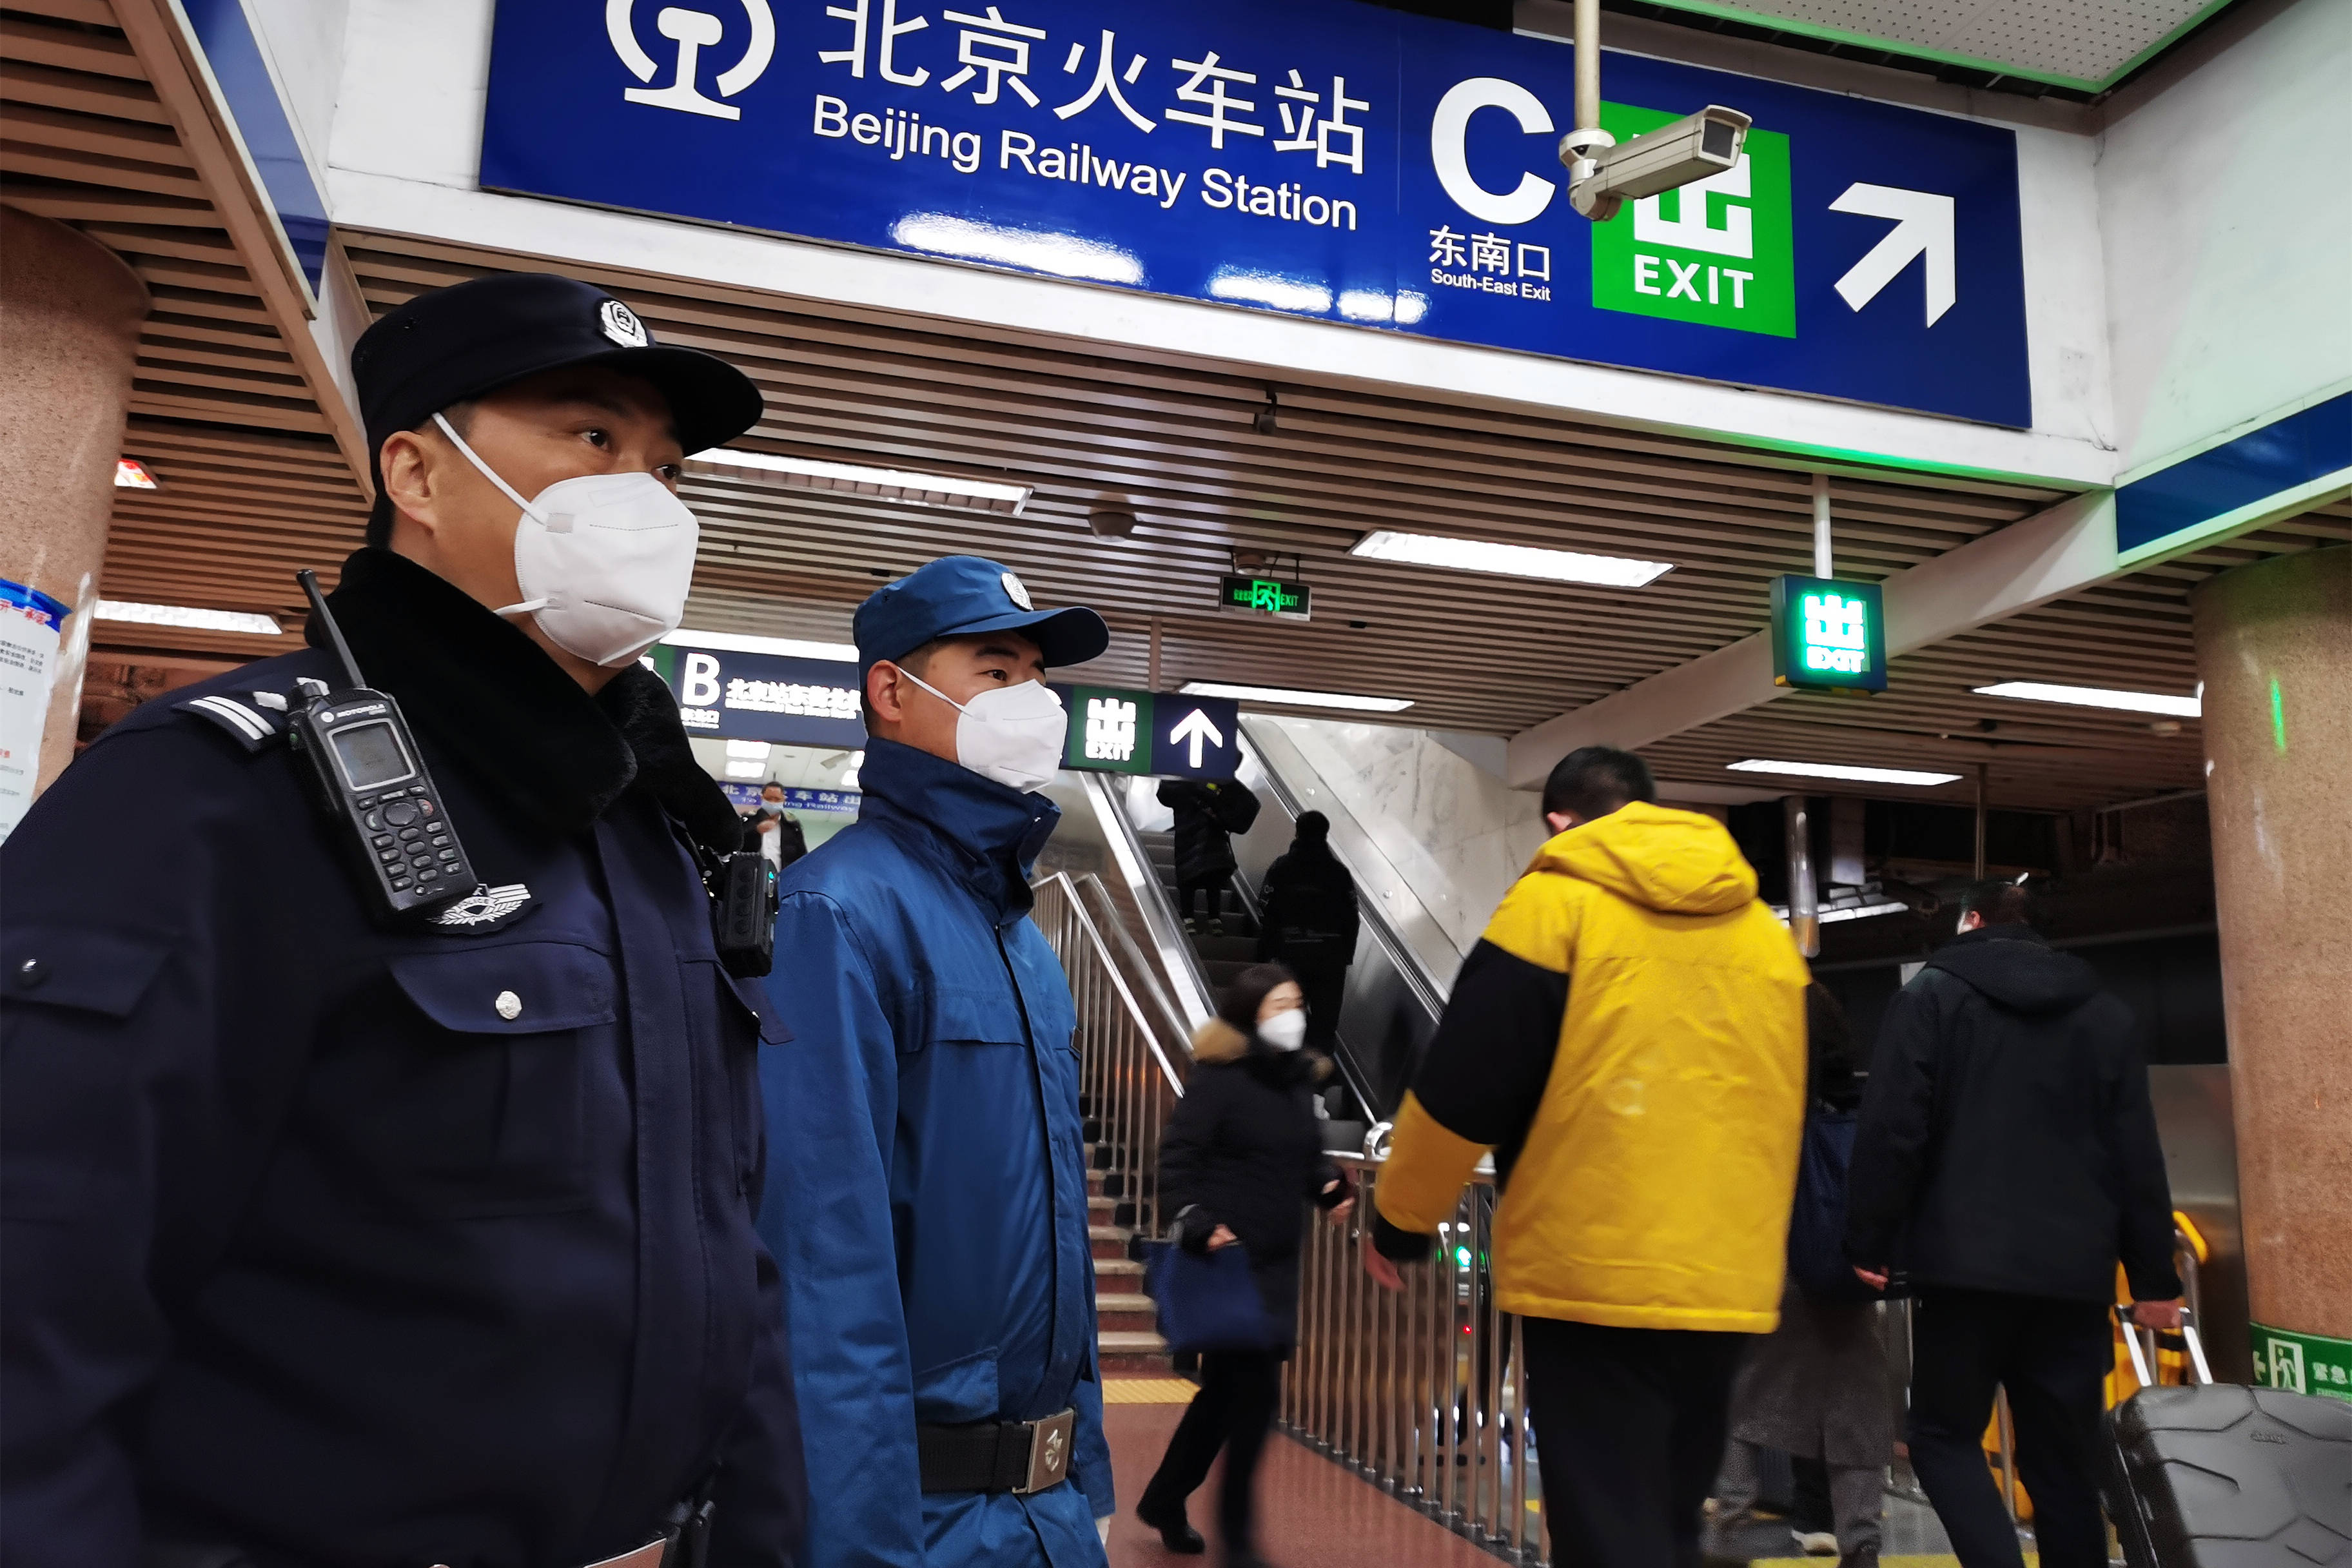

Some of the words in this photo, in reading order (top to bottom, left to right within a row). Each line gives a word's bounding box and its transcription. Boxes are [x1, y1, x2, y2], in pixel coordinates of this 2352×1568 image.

[818, 0, 1369, 174] 北京火车站
[813, 94, 981, 173] Beijing
[1000, 130, 1186, 209] Railway
[1201, 168, 1356, 230] Station
[1431, 77, 1556, 224] C
[1429, 224, 1551, 282] 东南口
[1431, 268, 1518, 297] South-East
[1522, 282, 1551, 301] Exit
[1634, 253, 1754, 308] EXIT
[1280, 594, 1300, 607] EXIT
[682, 652, 721, 706] B
[1806, 645, 1865, 673] EXIT
[1085, 741, 1135, 761] EXIT
